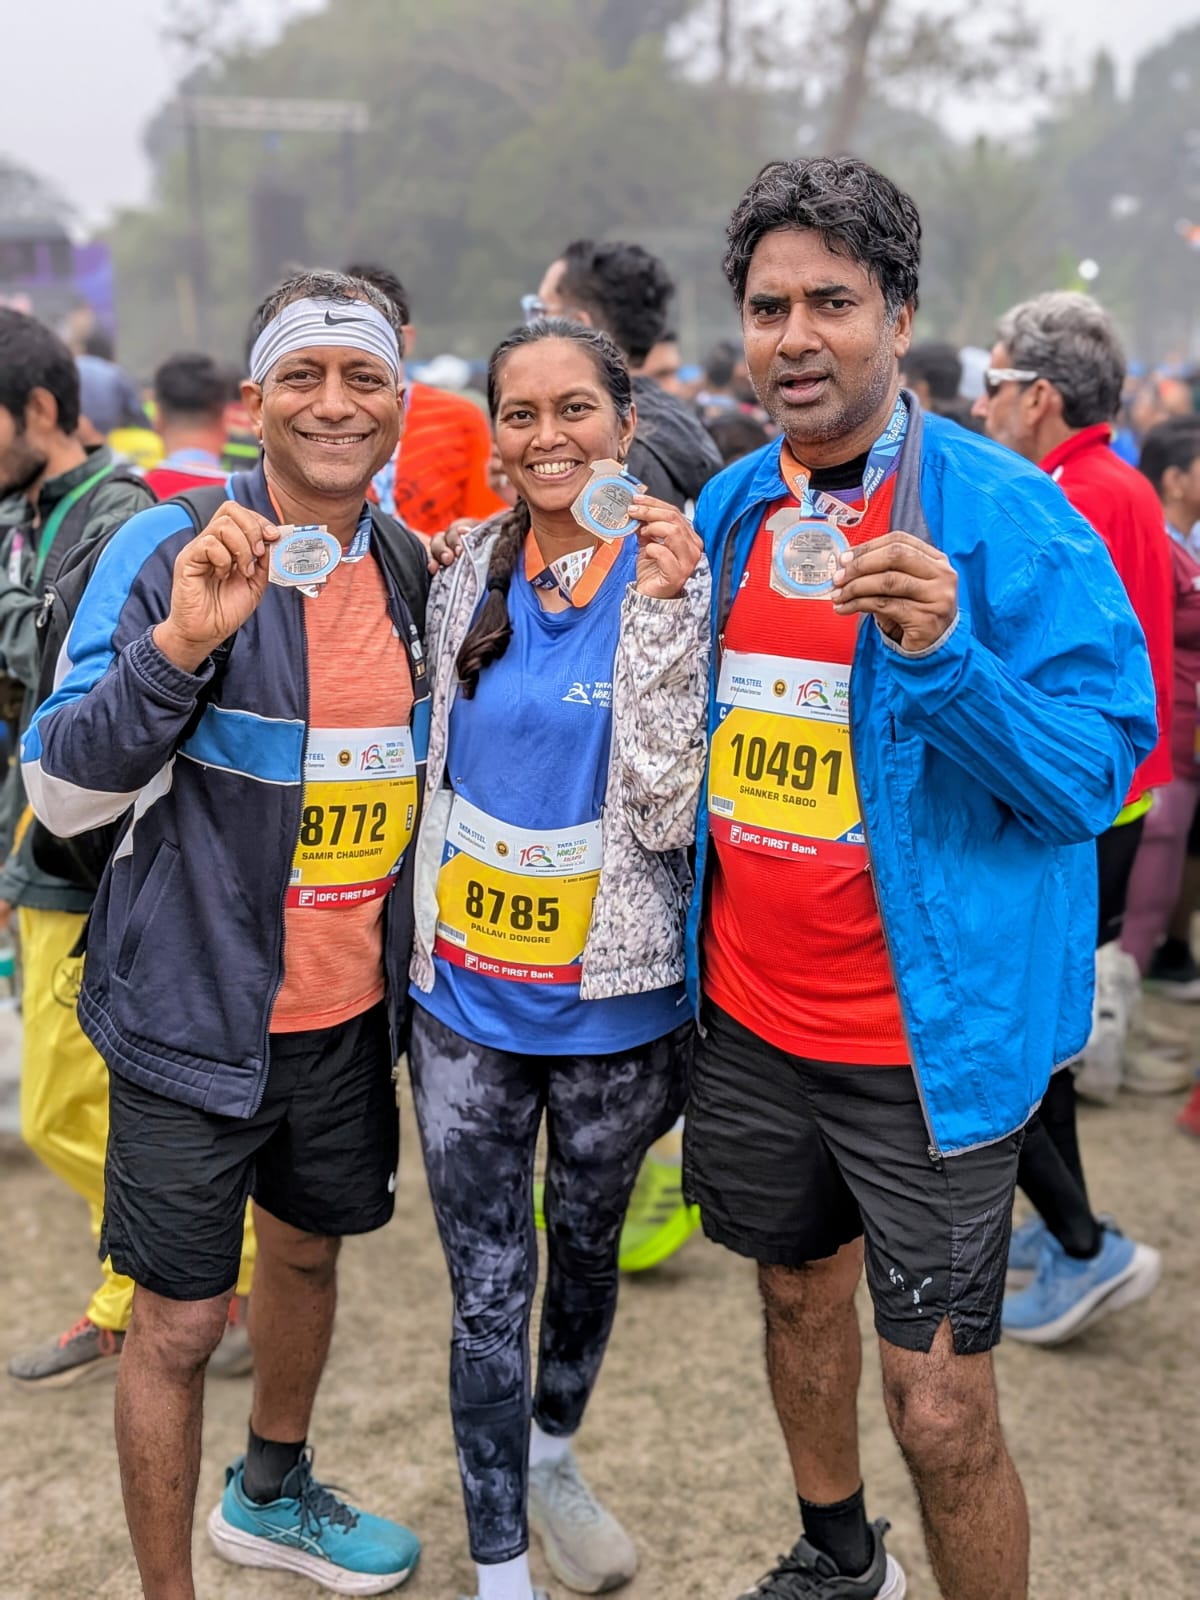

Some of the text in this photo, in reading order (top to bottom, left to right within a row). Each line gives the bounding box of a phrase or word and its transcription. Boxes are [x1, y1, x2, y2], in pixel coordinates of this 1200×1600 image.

[887, 417, 904, 441] TATA
[732, 676, 763, 688] TATA STEEL
[835, 681, 849, 689] TAT
[719, 706, 727, 719] C
[730, 733, 842, 796] 10491
[739, 785, 817, 808] SHANKER SABOO
[300, 802, 387, 846] 8772
[302, 847, 383, 860] SAMIR CHAUDHARY
[741, 831, 818, 856] IDFC FIRST Bank
[316, 887, 377, 903] IDFC FIRST Bank
[465, 880, 560, 933] 8785
[470, 922, 551, 944] PALLAVI DONGRE
[479, 962, 555, 980] IDFC FIRST Bank
